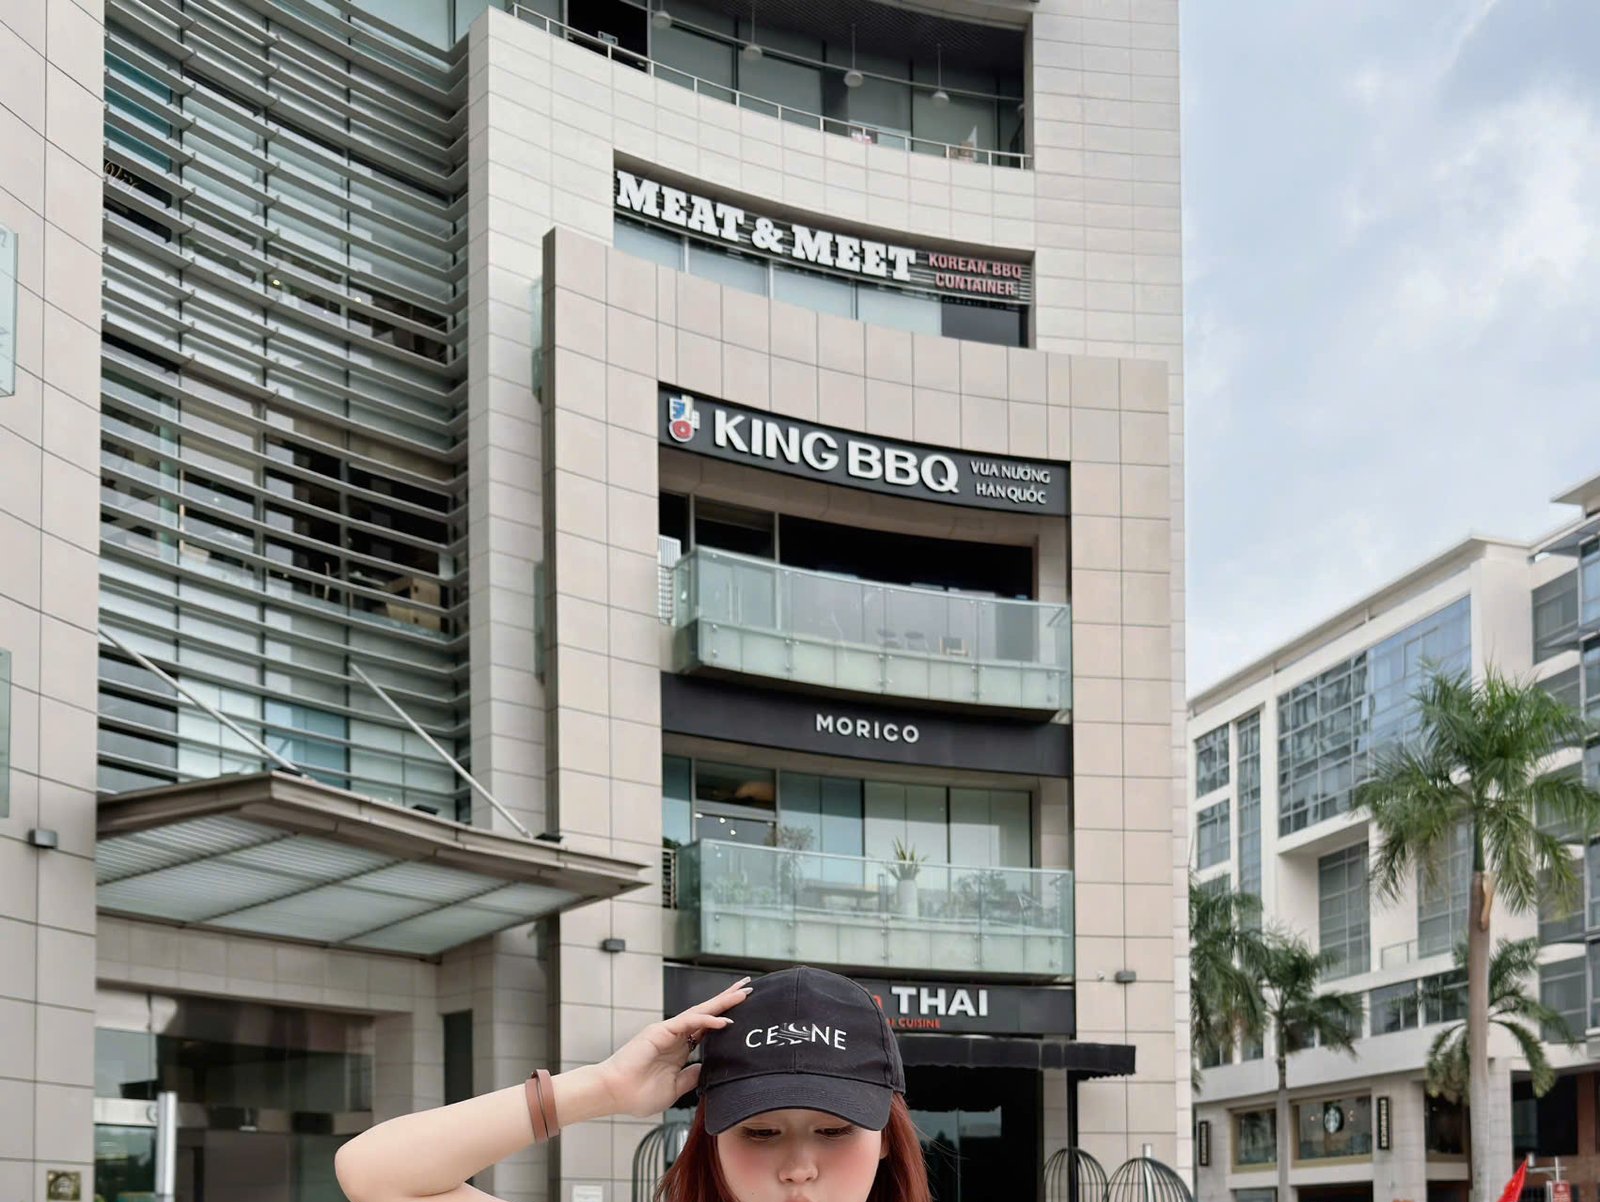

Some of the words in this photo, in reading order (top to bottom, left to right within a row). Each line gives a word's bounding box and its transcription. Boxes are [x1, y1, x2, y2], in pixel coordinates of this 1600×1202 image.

[617, 171, 744, 242] MEAT
[751, 217, 784, 254] &
[792, 225, 916, 281] MEET
[928, 252, 987, 274] KOREAN
[992, 262, 1022, 280] BBQ
[935, 272, 1014, 295] CONTAINER
[714, 409, 839, 471] KING
[848, 441, 959, 494] BBQ
[970, 460, 999, 477] VUA
[815, 713, 919, 743] MORICO
[891, 986, 988, 1016] THAI
[745, 1022, 847, 1050] CENE
[899, 1018, 941, 1029] CUISINE
